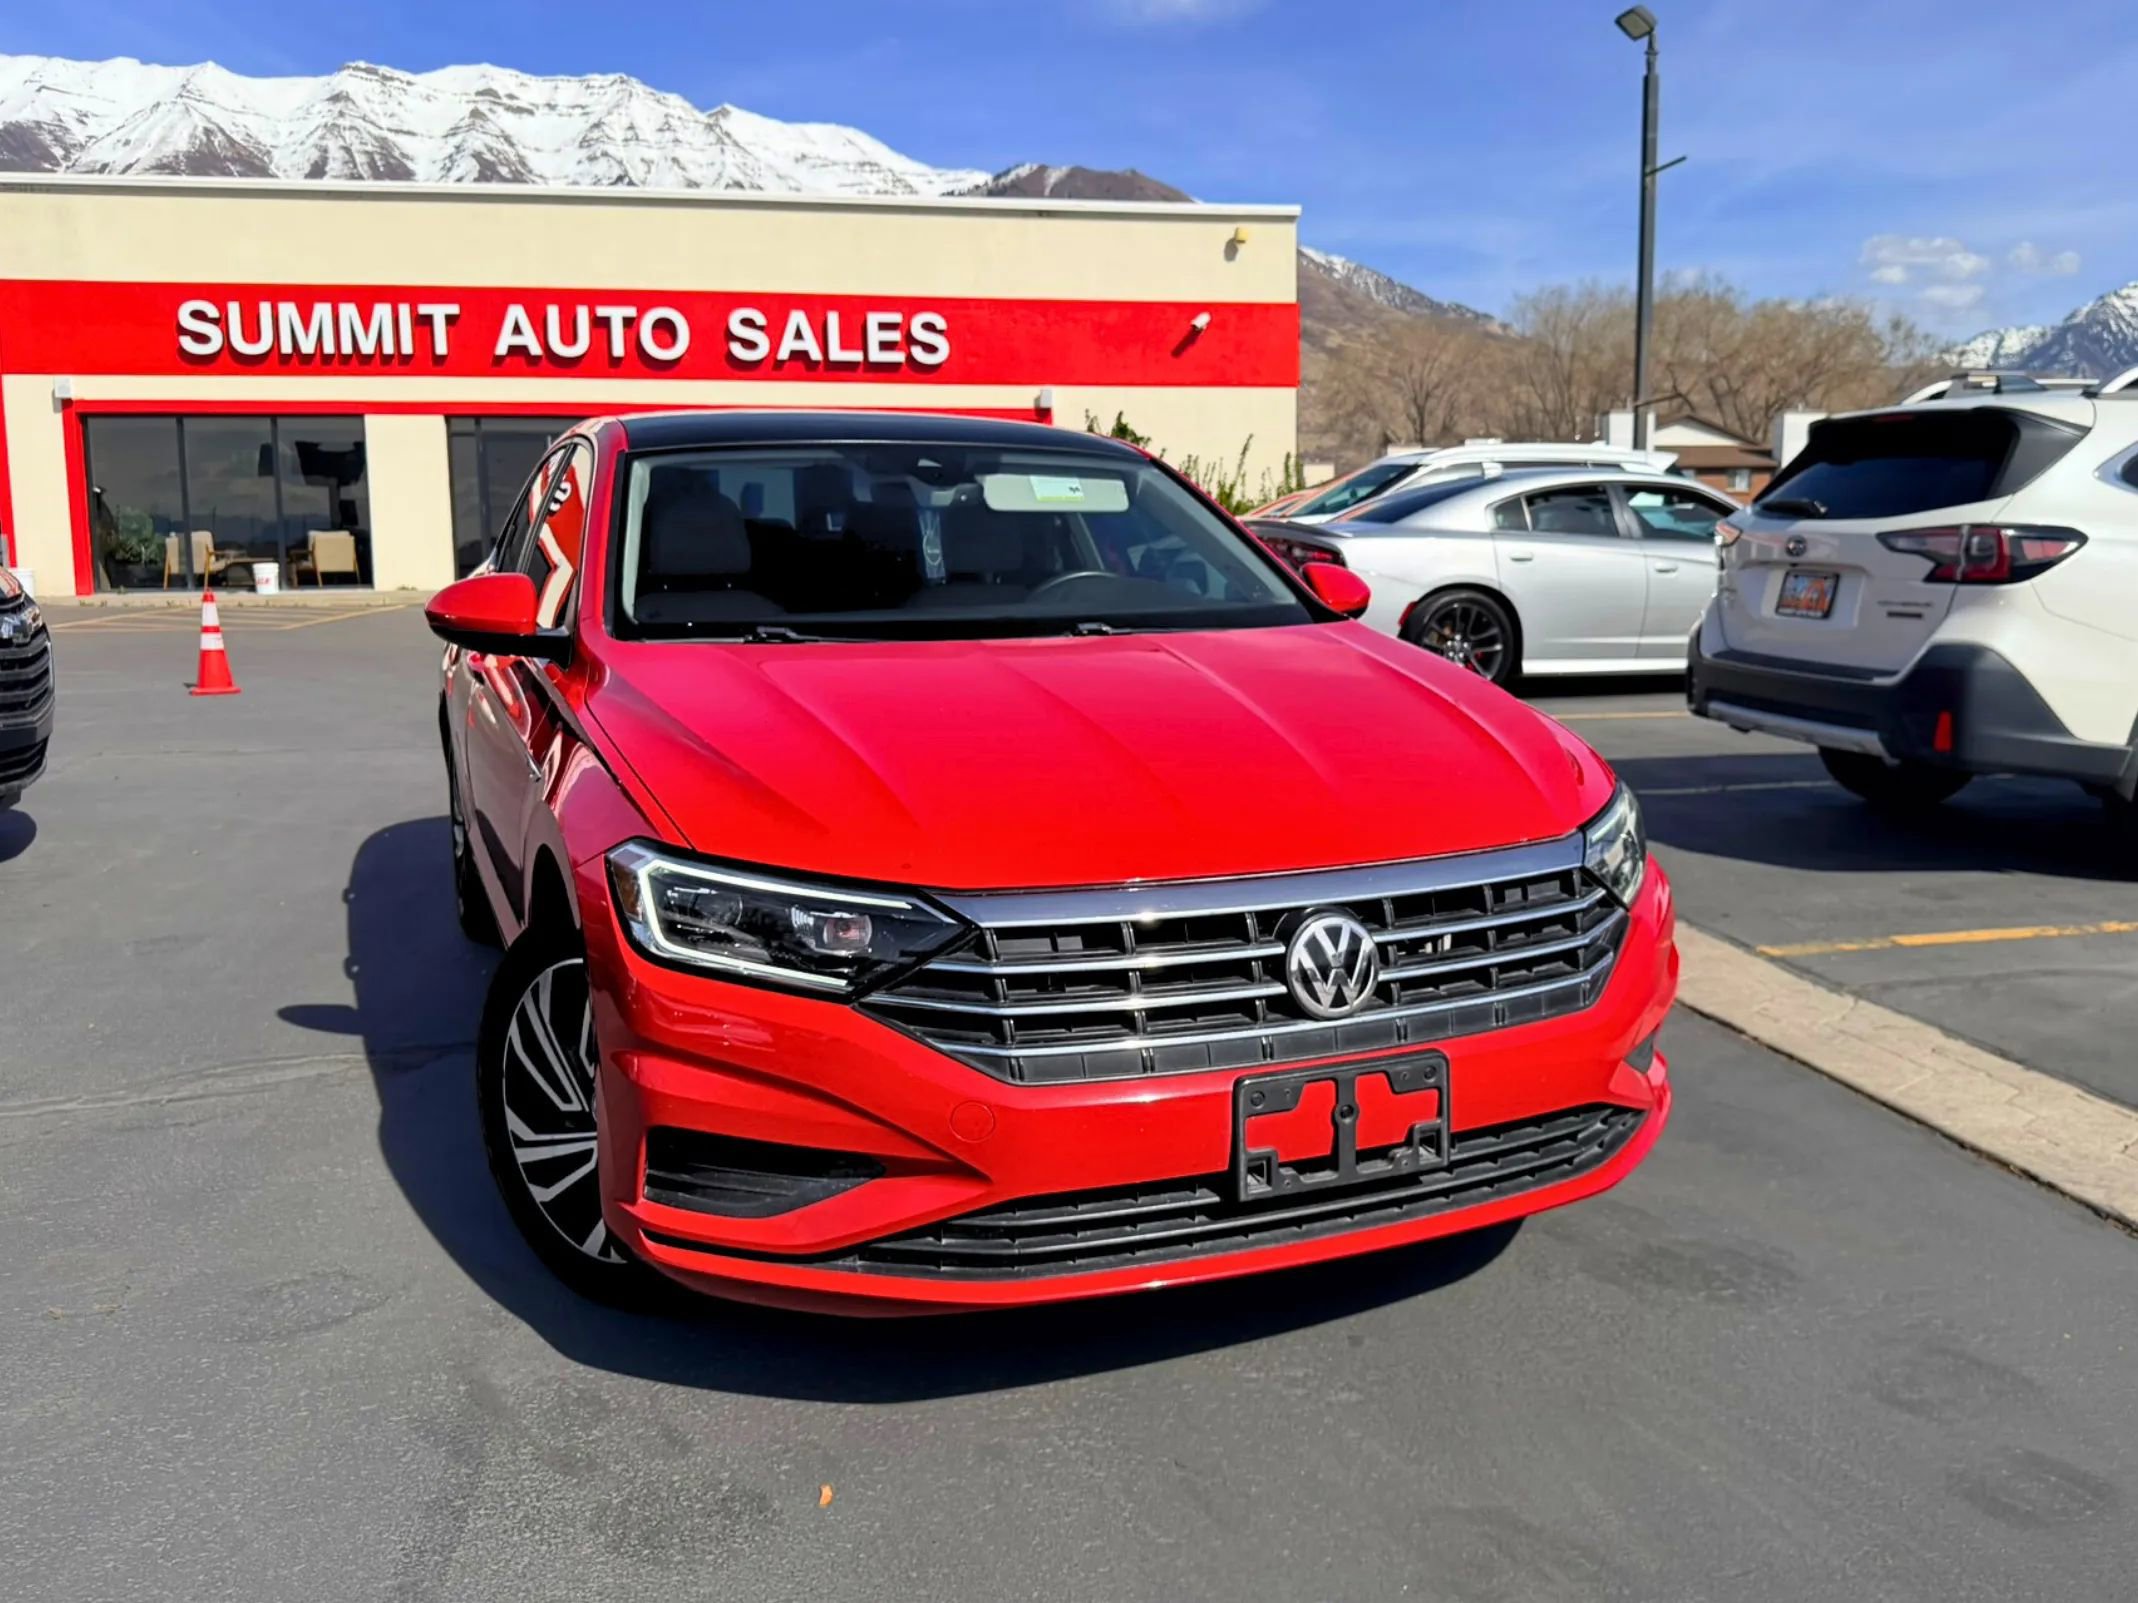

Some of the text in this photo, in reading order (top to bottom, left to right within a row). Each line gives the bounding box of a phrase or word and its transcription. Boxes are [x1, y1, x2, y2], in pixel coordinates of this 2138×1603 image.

[178, 299, 950, 367] SUMMIT AUTO SALES
[1289, 914, 1378, 1016] VW
